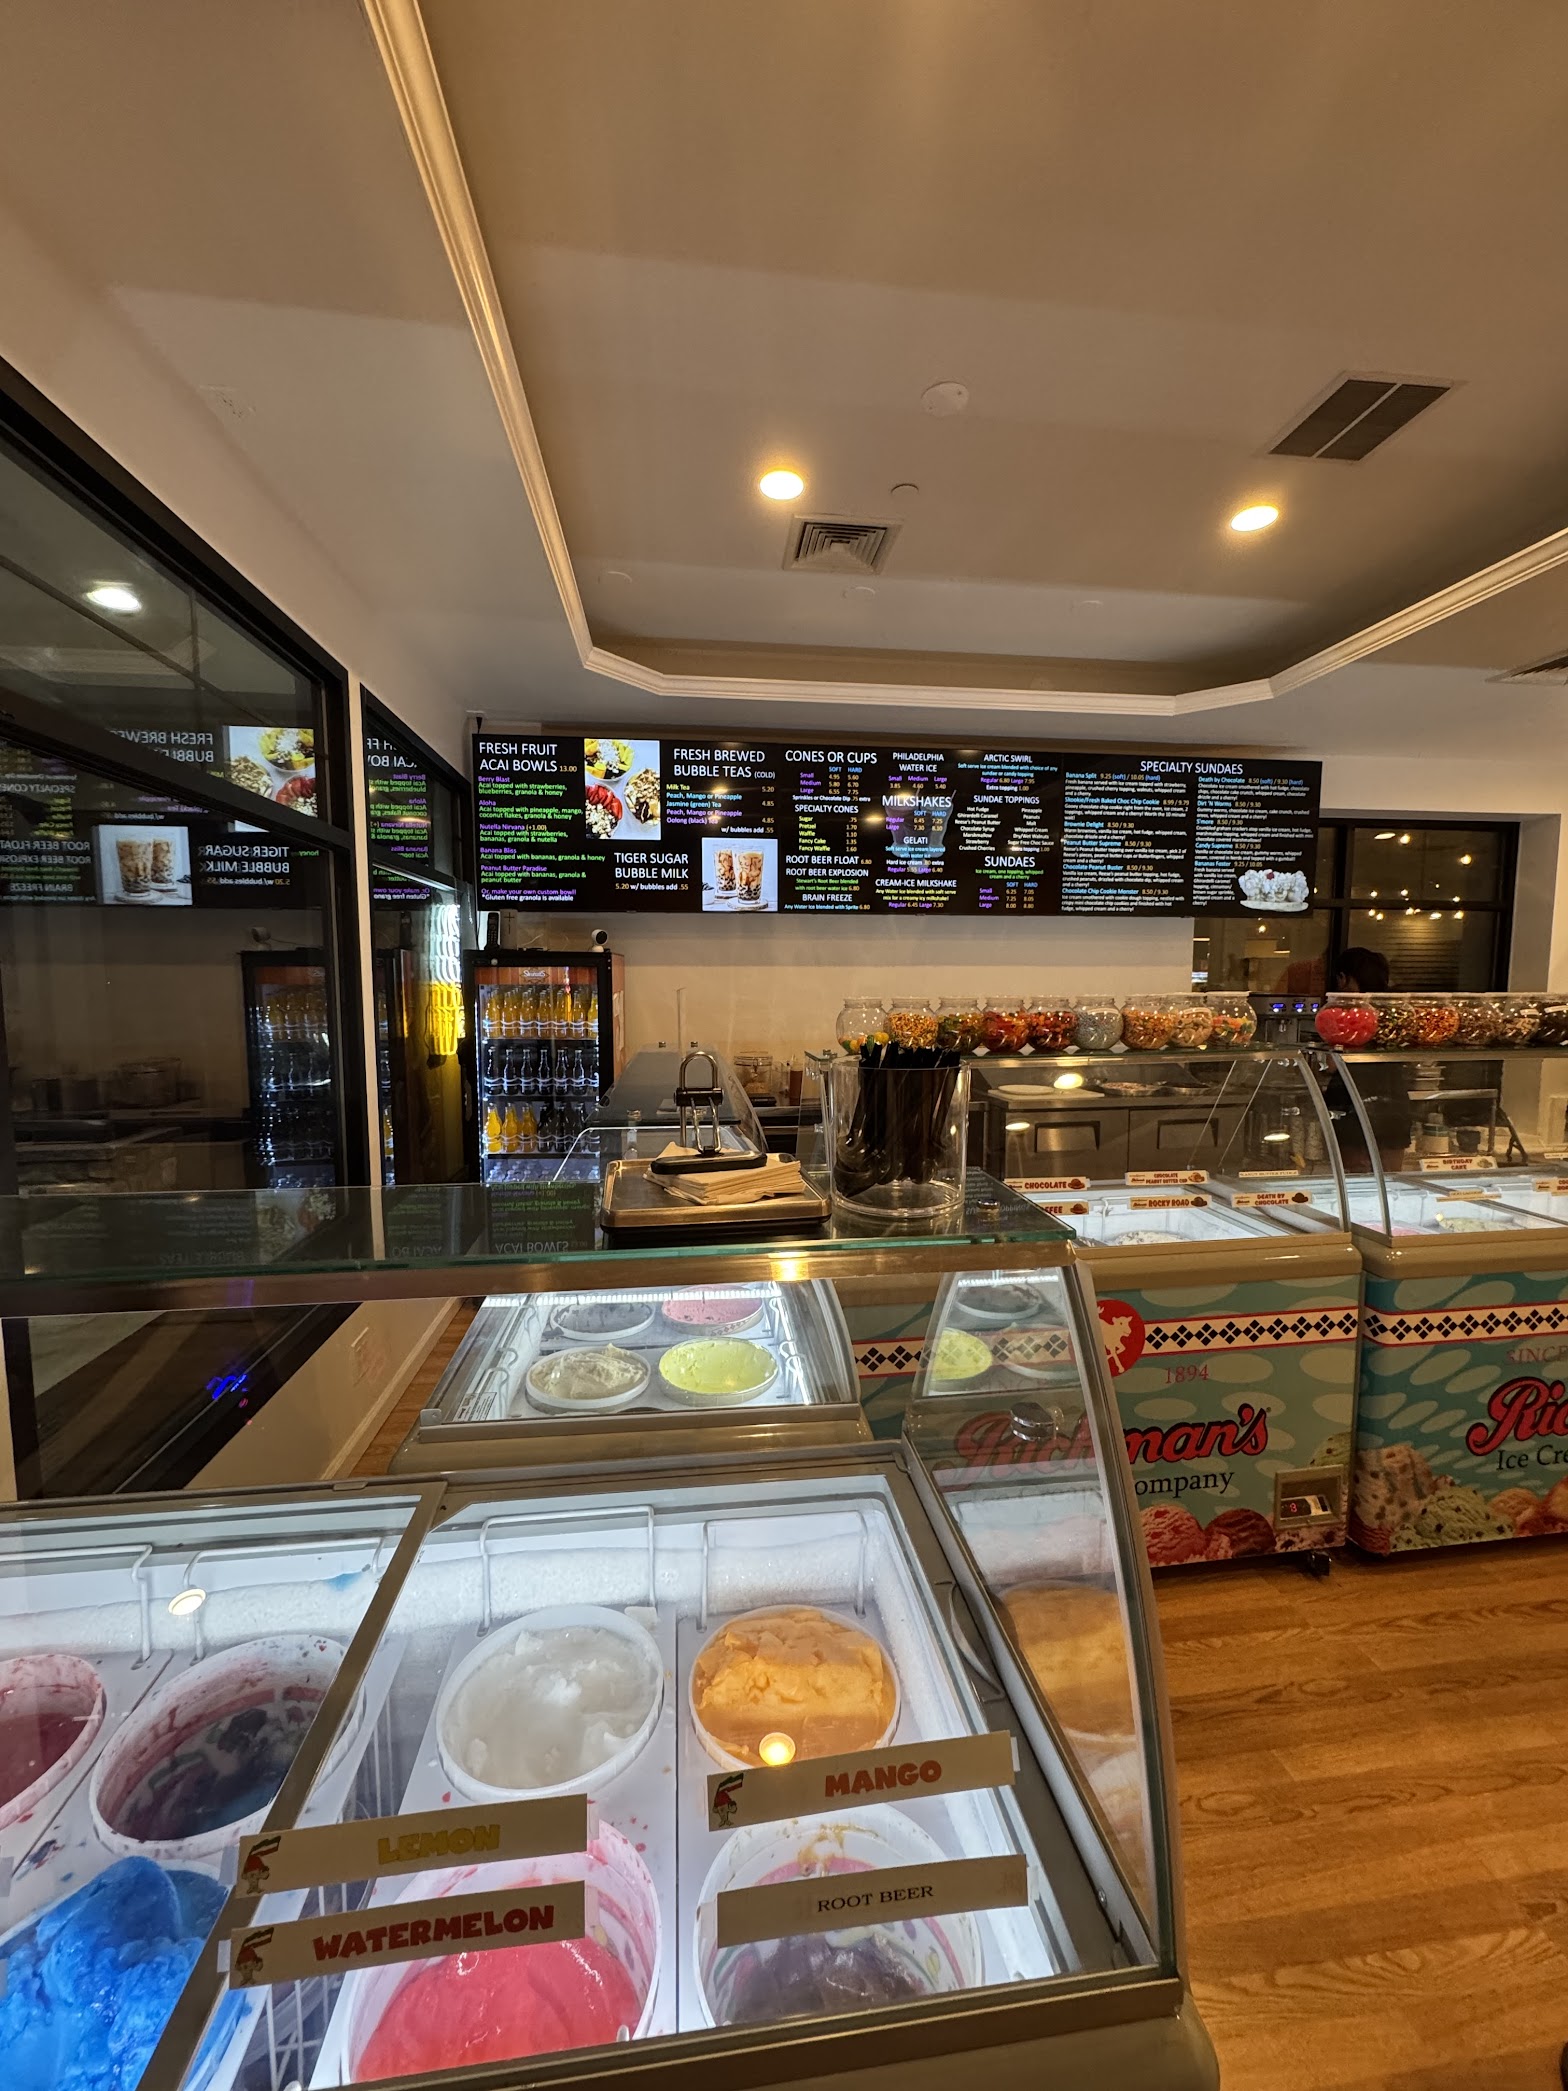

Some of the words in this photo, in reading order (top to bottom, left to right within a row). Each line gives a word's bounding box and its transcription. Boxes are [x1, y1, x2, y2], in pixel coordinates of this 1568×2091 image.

[479, 743, 517, 754] FRESH
[522, 744, 557, 755] FRUIT
[674, 749, 710, 761] FRESH
[714, 750, 765, 762] BREWED
[785, 750, 824, 762] CONES
[827, 751, 844, 763] OR
[847, 752, 877, 764] CUPS
[893, 753, 944, 761] PHILADELPHIA
[984, 754, 1009, 762] ARCTIC
[1011, 755, 1032, 763] SWIRL
[480, 759, 508, 770] ACAI
[513, 760, 557, 772] BOWLS
[899, 764, 924, 772] WATER
[926, 764, 937, 772] ICE
[1140, 761, 1193, 772] SPECIALTY
[1195, 763, 1243, 774] SUNDAES
[674, 765, 719, 777] BUBBLE
[723, 766, 751, 777] TEAS
[754, 771, 775, 779] (COLD)
[882, 796, 951, 807] MILKSHAKES
[974, 795, 1003, 803] SUNDAE
[1005, 796, 1039, 804] TOPPINGS
[795, 804, 832, 812] SPECIALTY
[833, 805, 858, 813] CONES
[904, 837, 928, 845] GELATI
[614, 852, 647, 863] TIGER
[650, 853, 688, 864] SUGAR
[786, 855, 809, 863] ROOT
[811, 856, 832, 864] BEER
[834, 856, 859, 864] FLOAT
[984, 856, 1035, 867] SUNDAES
[615, 868, 657, 878] BUBBLE
[661, 868, 689, 879] MILK
[786, 868, 807, 876] ROOT
[829, 869, 868, 877] EXPLOSION
[875, 879, 915, 887] CREAM-ICE
[917, 879, 957, 888] MILKSHAKE
[827, 894, 852, 902] FREEZE
[1165, 1364, 1209, 1384] 1894
[1496, 1450, 1528, 1470] Ice
[1135, 1472, 1234, 1498] ompany
[825, 1760, 942, 1798] MANGO
[378, 1824, 500, 1865] LEMON
[817, 1893, 874, 1913] ROOT
[880, 1885, 934, 1903] BEER
[312, 1905, 554, 1962] WATERMELON
